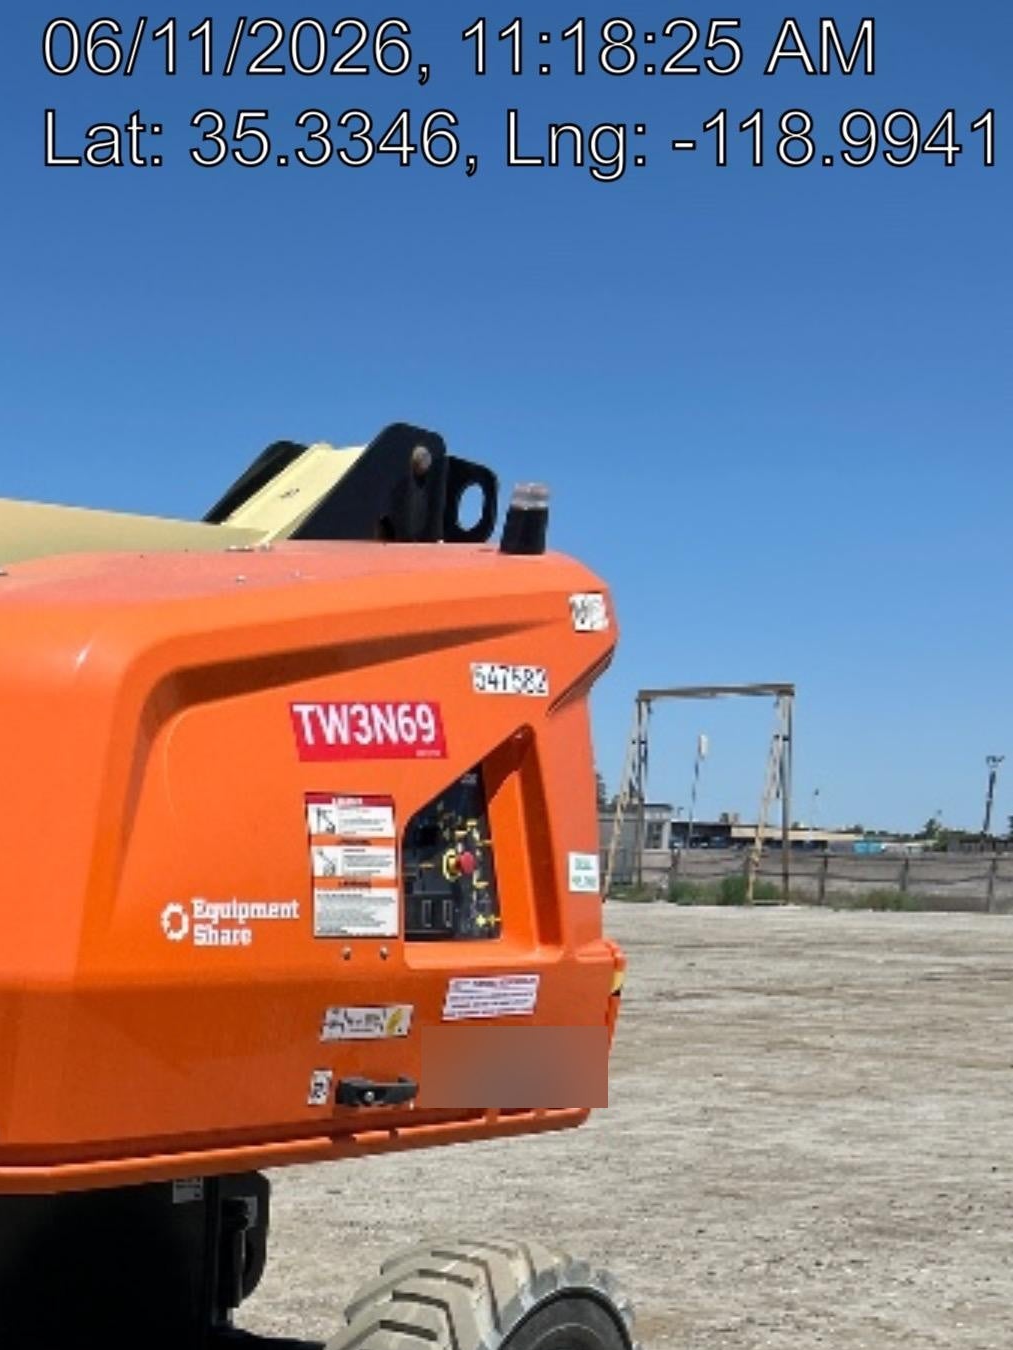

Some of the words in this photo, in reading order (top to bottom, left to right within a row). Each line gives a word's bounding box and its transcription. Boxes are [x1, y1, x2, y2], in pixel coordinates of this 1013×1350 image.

[473, 664, 547, 694] 547582
[292, 703, 436, 745] TW3N69
[191, 897, 300, 925] Equipment
[193, 924, 252, 946] Share
